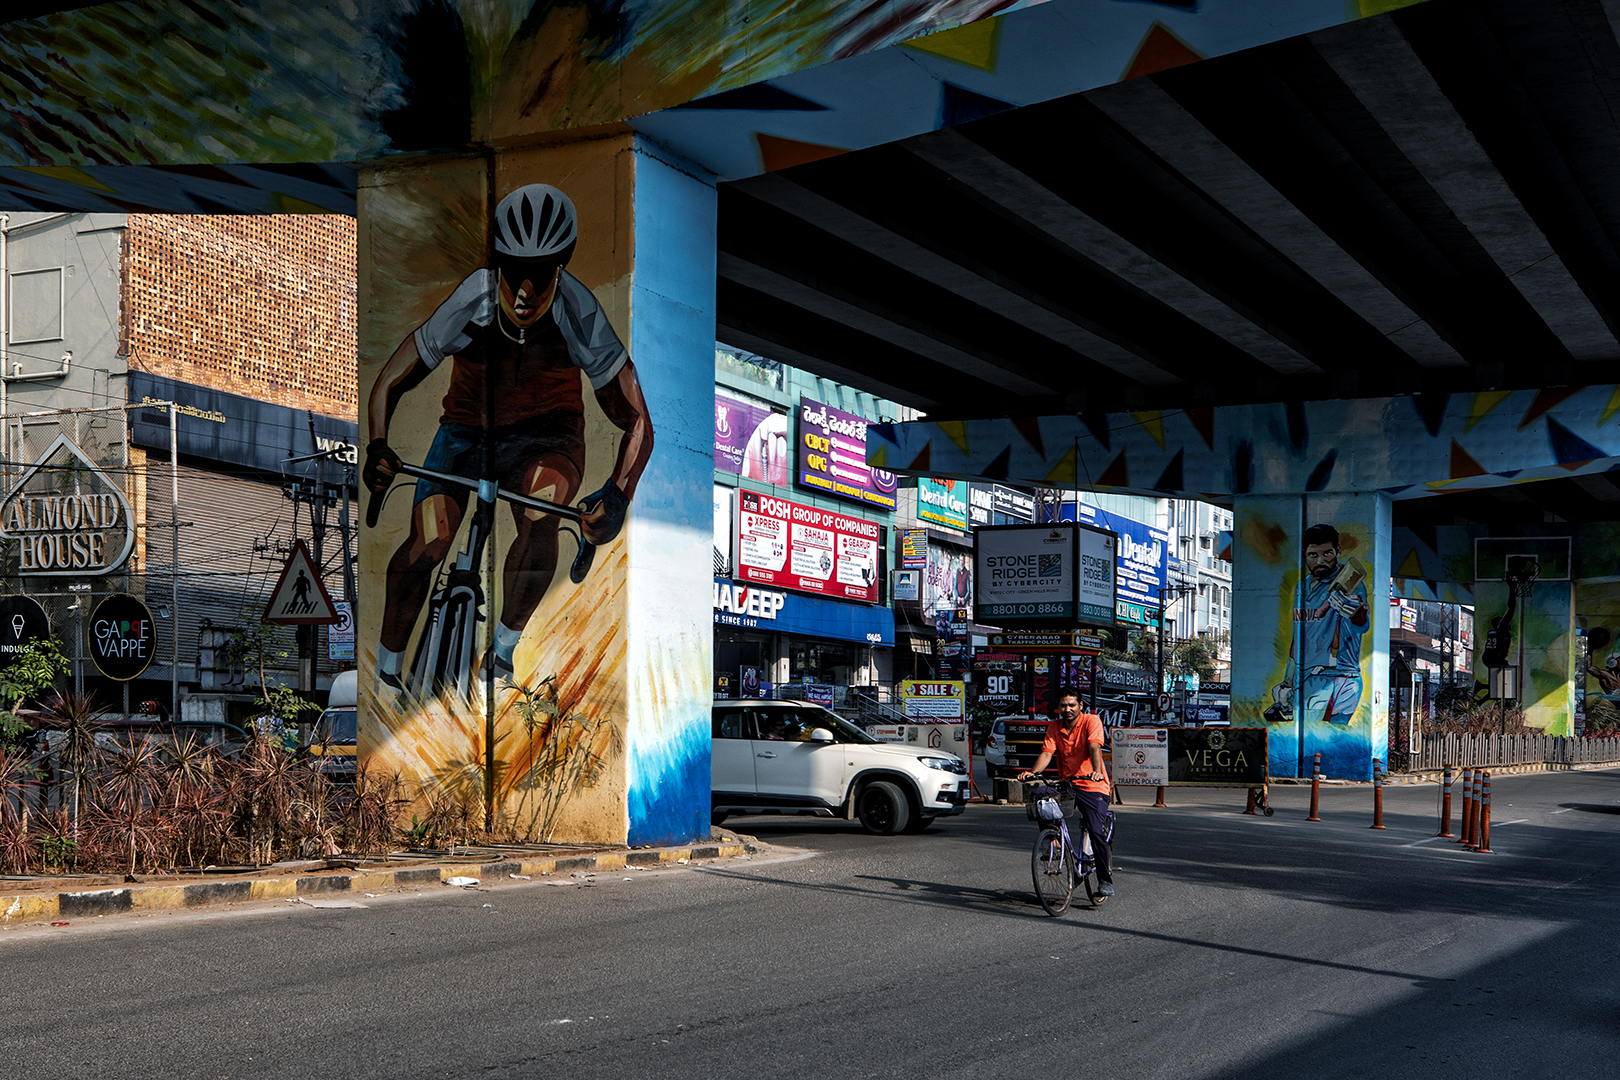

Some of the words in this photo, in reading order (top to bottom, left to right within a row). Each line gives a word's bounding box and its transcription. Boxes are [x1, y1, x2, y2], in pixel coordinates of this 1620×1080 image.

[716, 441, 731, 453] Dental
[731, 446, 743, 456] Care
[805, 433, 830, 453] CBCT
[807, 454, 827, 472] OPG
[921, 485, 948, 508] Dental
[949, 495, 966, 514] Care
[4, 493, 120, 532] ALMOND
[760, 496, 790, 520] POSH
[792, 507, 821, 525] GROUP
[822, 514, 834, 527] OF
[834, 517, 878, 538] COMPANIES
[754, 516, 780, 531] XPRESS
[804, 528, 829, 542] SAHAJA
[19, 532, 108, 569] HOUSE
[848, 538, 871, 549] GEARUP
[987, 555, 1037, 567] STONE
[1081, 554, 1102, 569] STONE
[992, 568, 1037, 579] RIDGE
[1083, 568, 1102, 581] RIDGE
[1089, 582, 1111, 590] CYBERCITY
[992, 605, 1016, 615] 8801
[1018, 604, 1035, 614] 00
[1038, 603, 1064, 613] 8866
[1083, 606, 1094, 614] 8801
[1094, 607, 1100, 615] 00
[1292, 608, 1321, 623] INDIA
[721, 615, 740, 625] SINCE
[94, 619, 149, 639] GAPPE
[97, 639, 147, 658] VAPPE
[1486, 637, 1498, 646] 29
[1103, 669, 1125, 685] Karachi
[1126, 672, 1145, 690] Bakery
[919, 684, 947, 696] SALE
[978, 694, 1020, 702] AUTHENTIC
[1185, 749, 1249, 767] VEGA
